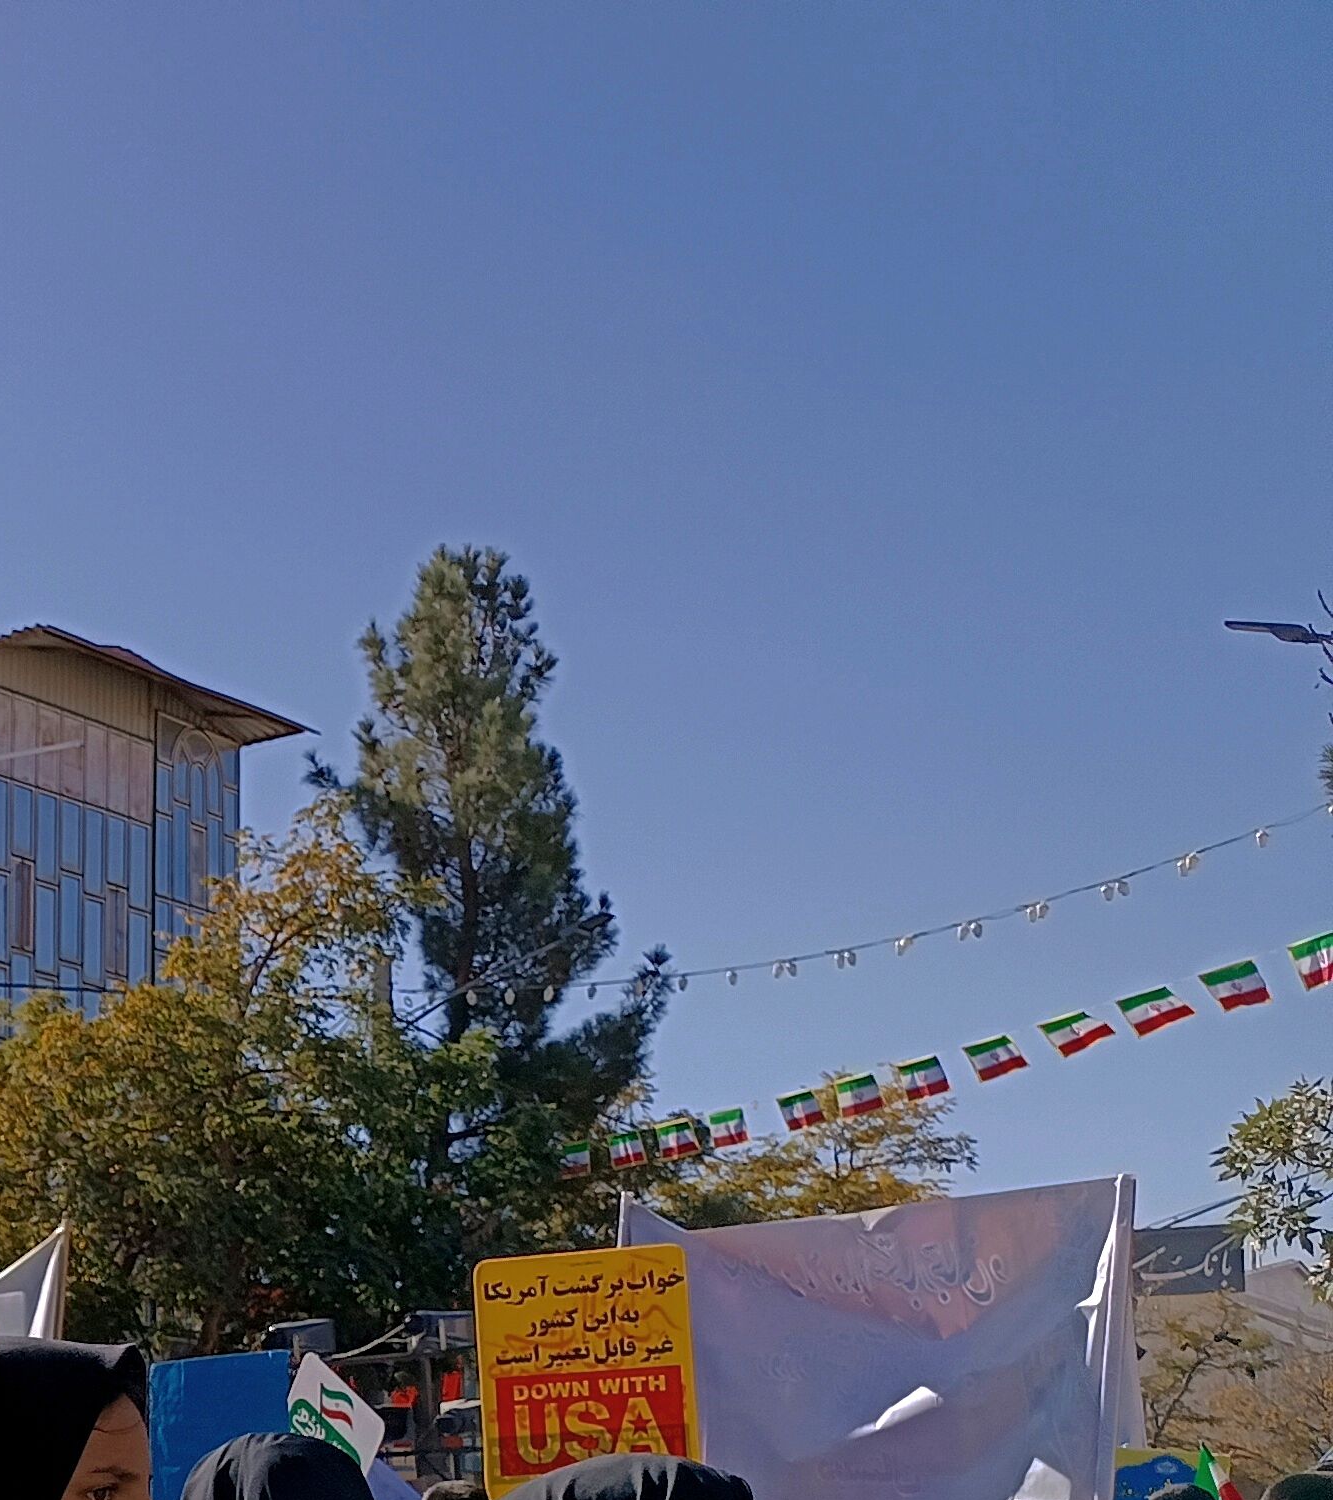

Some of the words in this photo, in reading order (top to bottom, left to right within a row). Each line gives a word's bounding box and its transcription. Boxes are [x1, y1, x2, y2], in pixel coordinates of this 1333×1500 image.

[483, 1276, 549, 1306] آمریکا
[626, 1268, 685, 1295] خواب
[525, 1307, 578, 1337] کشور
[583, 1305, 616, 1332] این
[617, 1308, 640, 1329] به
[495, 1344, 539, 1365] است
[547, 1339, 590, 1368] تعبیر
[594, 1336, 637, 1364] قابل
[641, 1335, 674, 1362] غیر
[513, 1380, 589, 1401] DOWN
[598, 1374, 666, 1395] WITH
[514, 1396, 671, 1465] USA
